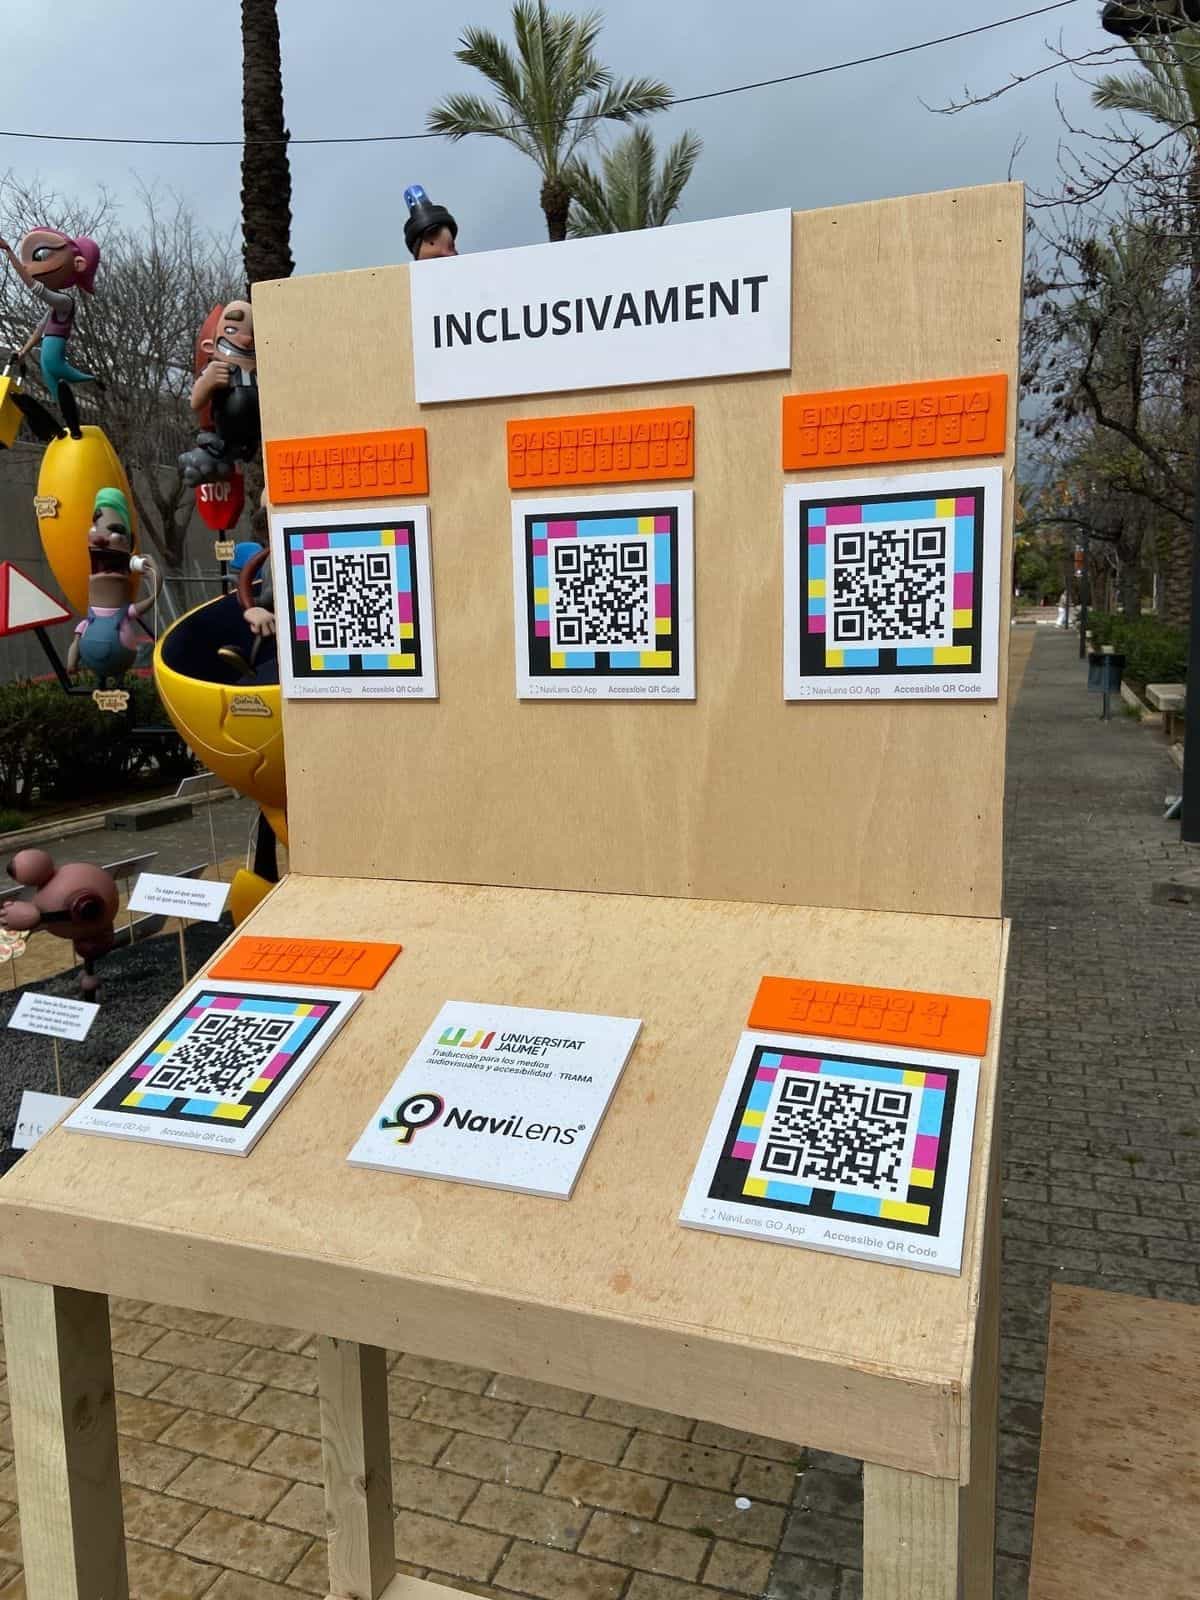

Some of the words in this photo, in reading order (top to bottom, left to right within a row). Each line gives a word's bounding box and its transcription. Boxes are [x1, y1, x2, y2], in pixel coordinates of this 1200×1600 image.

[433, 274, 769, 349] INCLUSIVAMENT
[802, 391, 984, 425] ENQUESTA
[511, 420, 686, 450] CASTELLANO
[200, 481, 232, 502] STOP
[572, 686, 583, 694] GO
[584, 686, 598, 695] App
[608, 685, 646, 694] Accessible
[647, 685, 660, 694] QR
[661, 685, 681, 694] Code
[812, 686, 848, 695] NaviLens
[849, 686, 864, 695] GO
[865, 686, 881, 696] App
[894, 684, 940, 694] Accessible
[942, 684, 956, 694] QR
[958, 684, 982, 693] Code
[495, 1042, 541, 1056] JAUME
[500, 1032, 586, 1051] UNIVERSITAT
[432, 1048, 479, 1060] Traducción
[479, 1054, 501, 1064] para
[501, 1056, 515, 1066] los
[516, 1059, 550, 1070] medios
[425, 1057, 485, 1071] audiovisuales
[493, 1065, 553, 1079] accesibilidad
[559, 1072, 593, 1084] TRAMA
[717, 1210, 763, 1228] NaviLens
[765, 1219, 784, 1230] GO
[785, 1221, 806, 1236] App
[823, 1229, 883, 1249] Accessible
[886, 1240, 904, 1252] QR
[907, 1243, 938, 1258] Code
